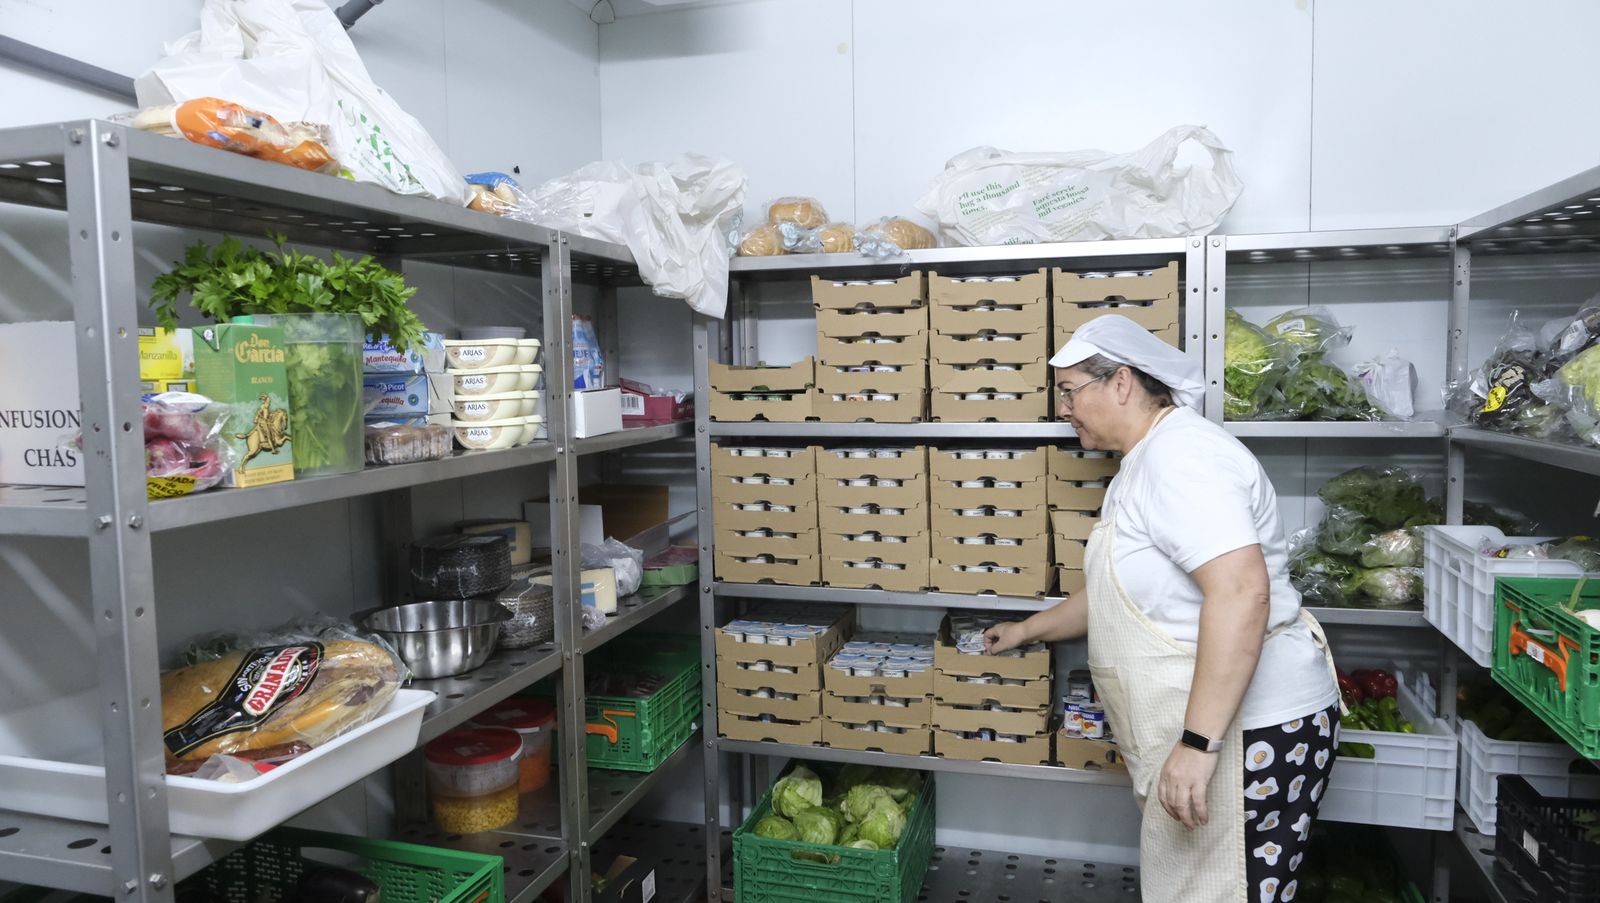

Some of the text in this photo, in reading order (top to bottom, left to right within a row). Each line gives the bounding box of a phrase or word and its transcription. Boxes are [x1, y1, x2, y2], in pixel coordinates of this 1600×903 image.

[959, 200, 975, 210] bag
[982, 180, 1021, 201] thousand
[971, 188, 986, 196] use
[986, 181, 1003, 191] this
[962, 205, 988, 216] times.
[251, 333, 270, 347] Don
[235, 340, 285, 363] García
